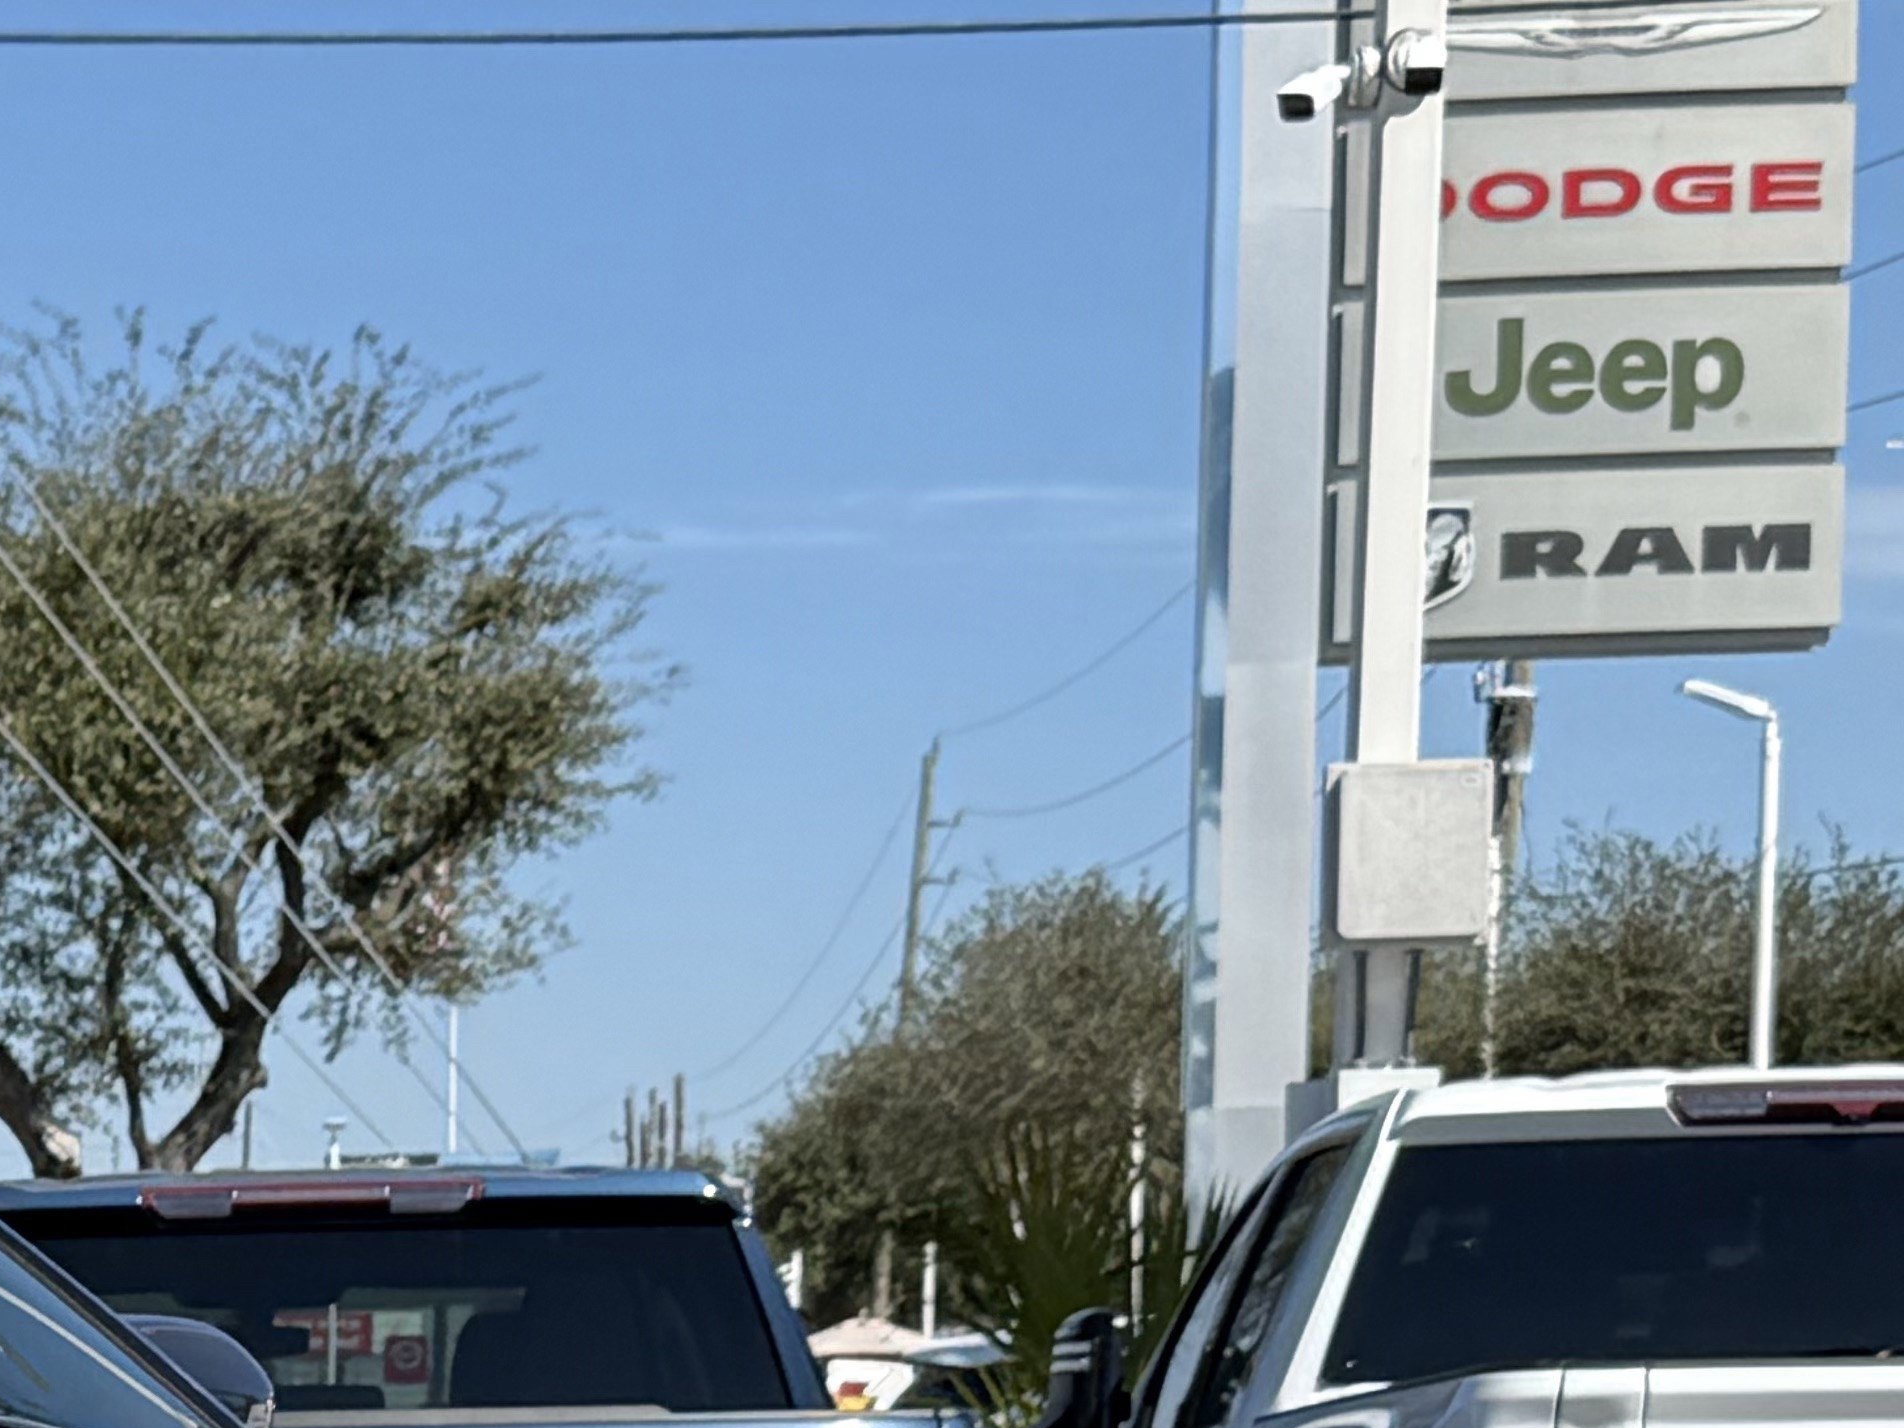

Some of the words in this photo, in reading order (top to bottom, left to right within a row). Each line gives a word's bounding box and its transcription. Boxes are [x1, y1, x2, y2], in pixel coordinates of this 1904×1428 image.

[1441, 161, 1824, 222] ODGE
[1444, 317, 1745, 431] Jeep
[1499, 523, 1812, 581] RAM
